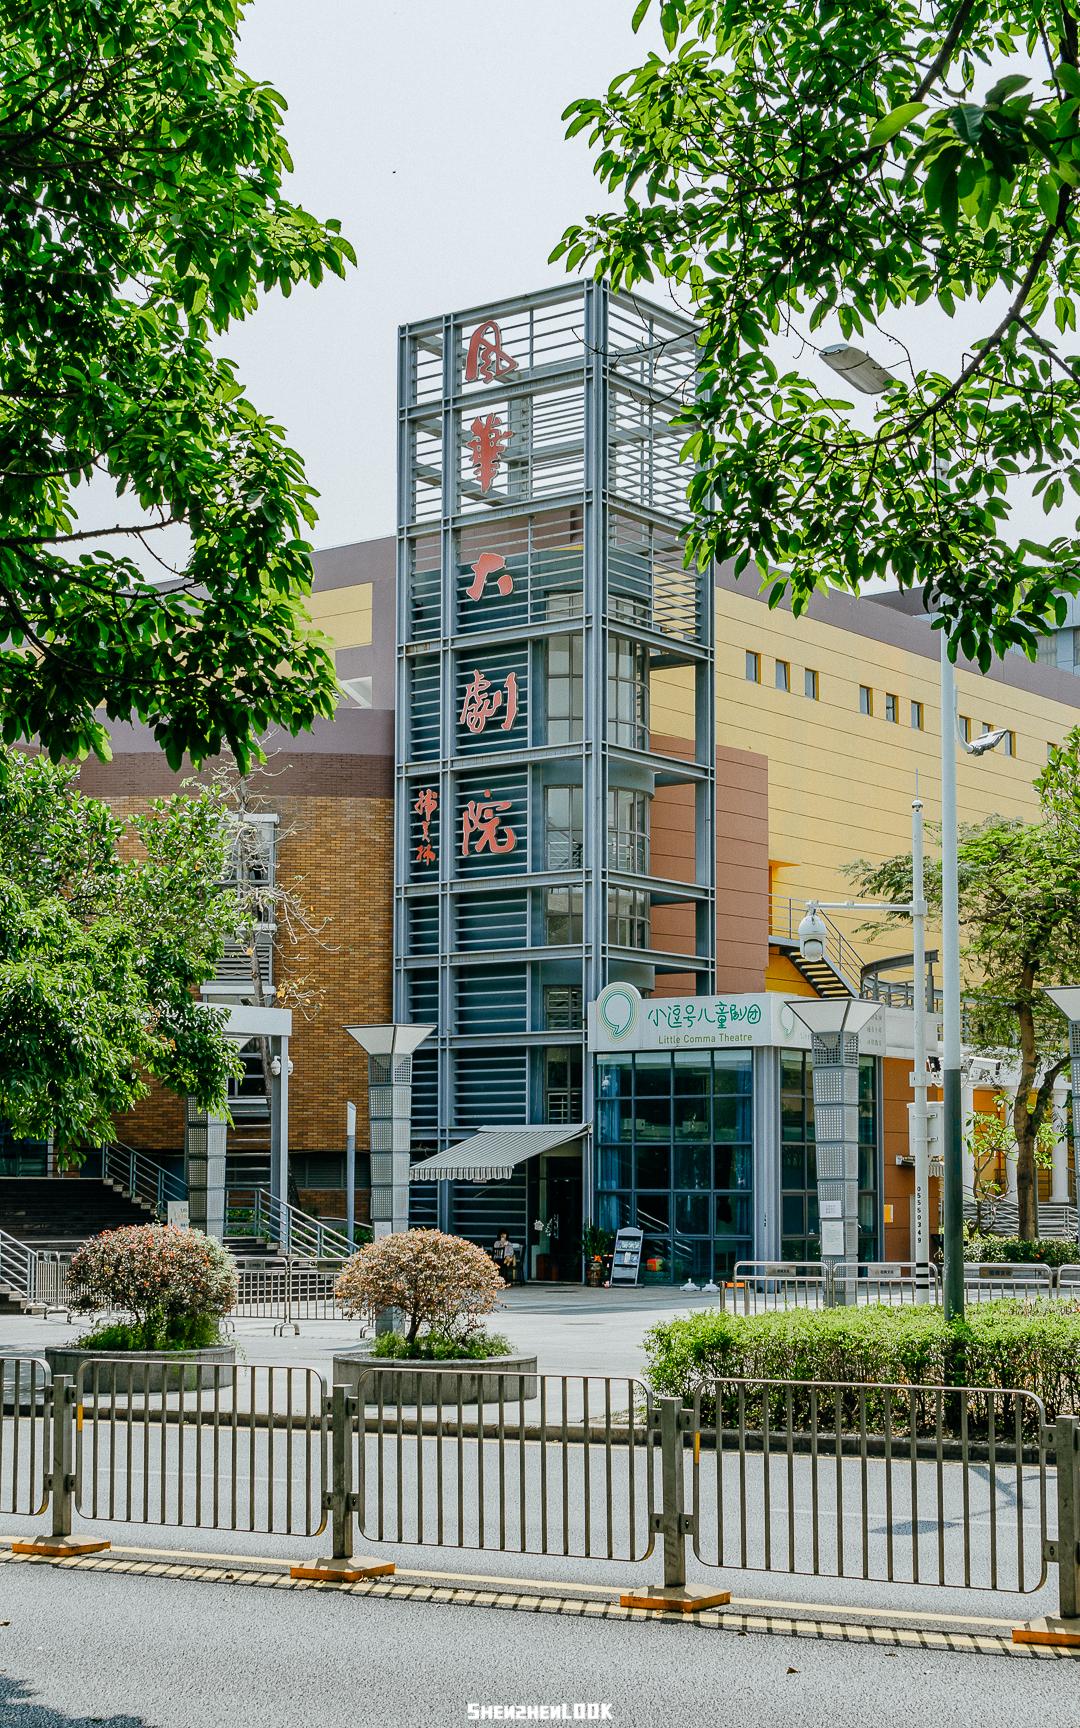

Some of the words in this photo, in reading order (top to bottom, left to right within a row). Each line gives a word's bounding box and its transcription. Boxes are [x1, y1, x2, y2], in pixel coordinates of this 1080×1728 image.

[648, 1001, 761, 1031] 小逗号儿童剧团
[658, 1036, 681, 1048] Little
[684, 1034, 716, 1046] Comma
[719, 1033, 753, 1046] Theatre
